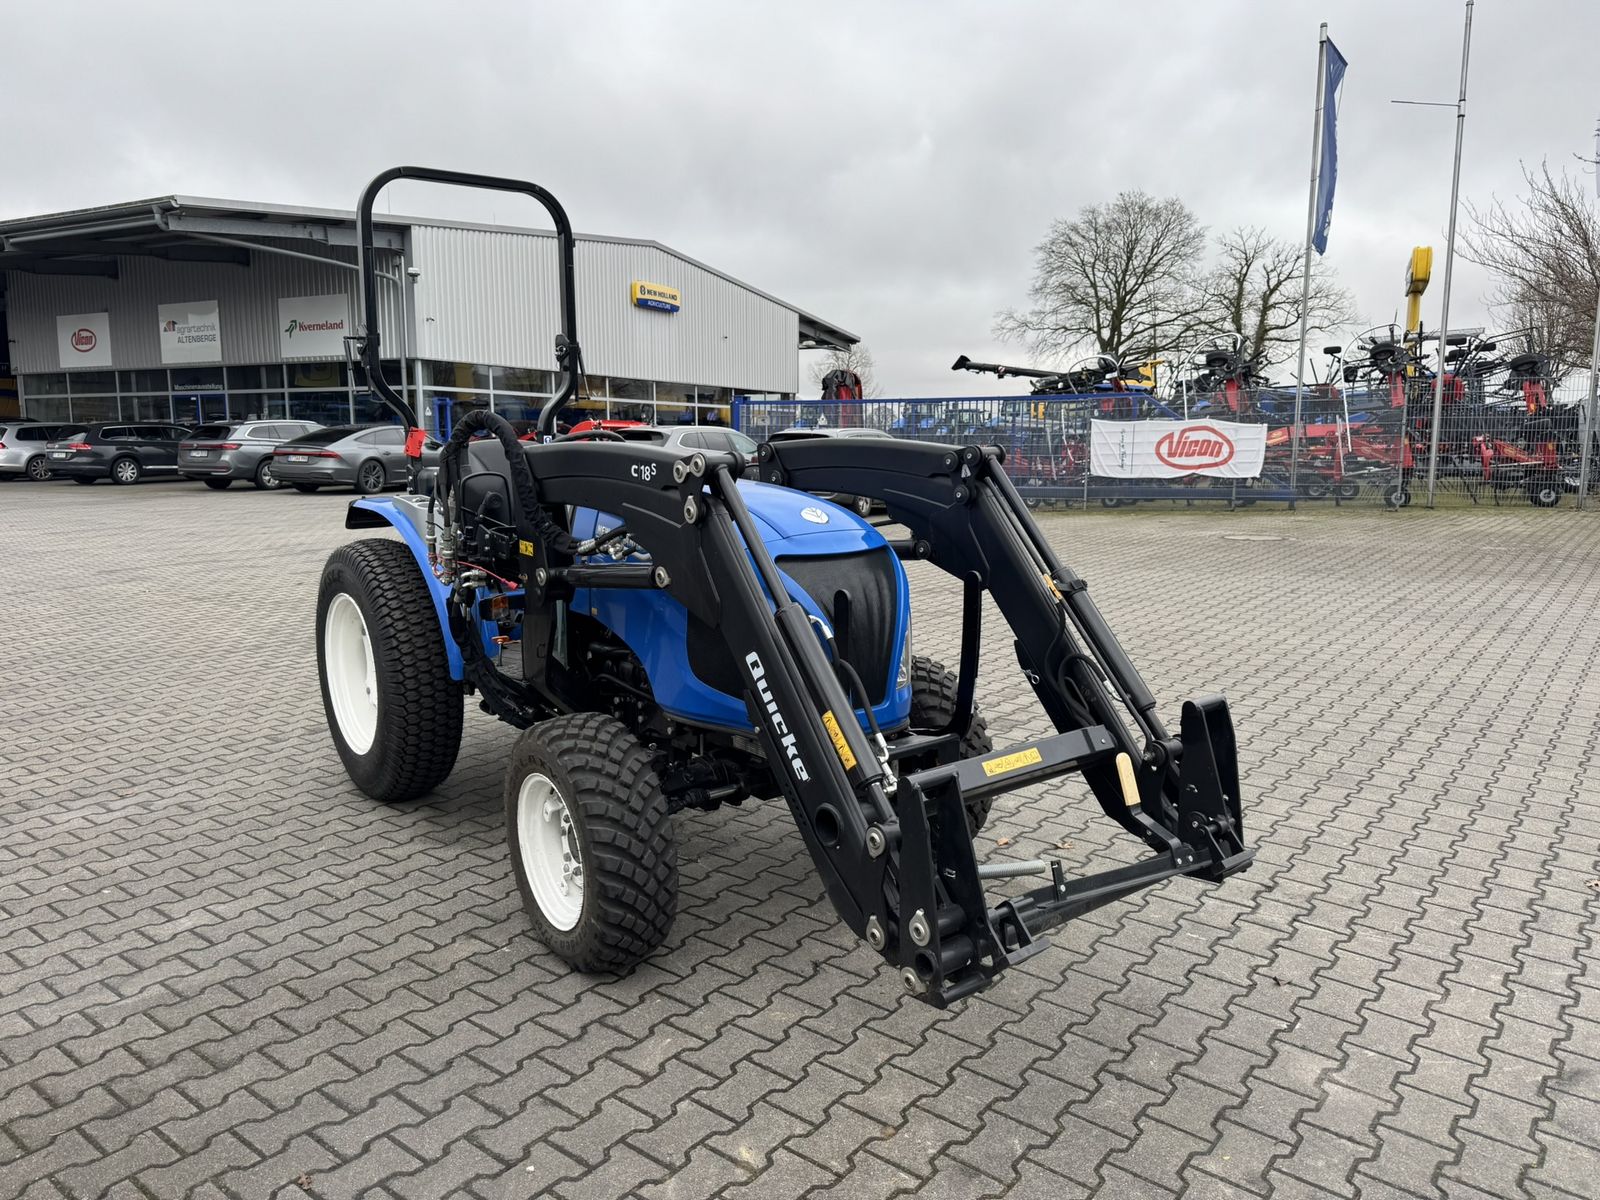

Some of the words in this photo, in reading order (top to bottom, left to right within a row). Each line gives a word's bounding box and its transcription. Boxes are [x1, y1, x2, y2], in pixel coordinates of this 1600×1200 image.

[647, 289, 657, 297] NEW
[657, 291, 677, 301] HOLLAND
[176, 322, 217, 334] agrartechnik
[298, 319, 344, 332] Kverneland
[73, 330, 94, 347] Vicon
[177, 333, 217, 344] ALTENBERGE
[1165, 430, 1225, 460] Vicon
[745, 651, 810, 782] Quicke
